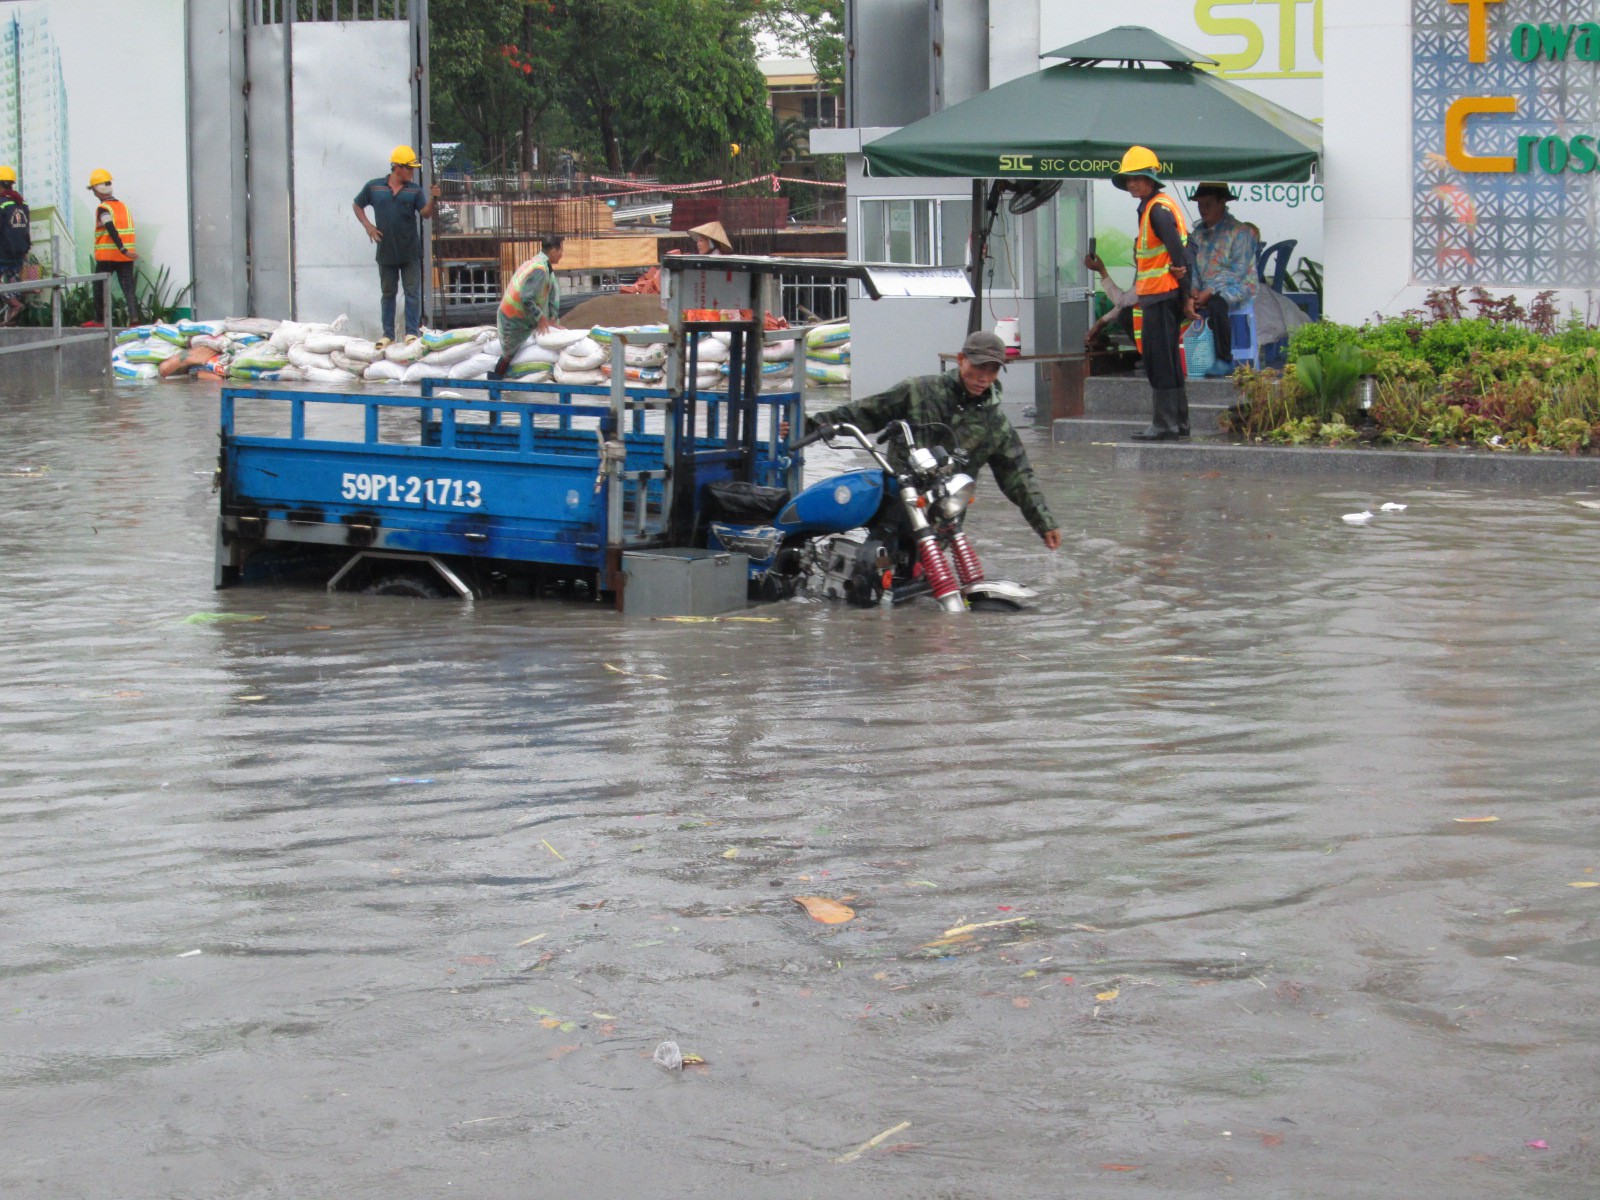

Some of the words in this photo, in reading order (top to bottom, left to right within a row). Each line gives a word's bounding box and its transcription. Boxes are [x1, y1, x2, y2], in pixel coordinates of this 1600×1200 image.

[1193, 0, 1323, 76] ST
[1445, 97, 1600, 174] Cros
[999, 155, 1033, 171] STC
[1040, 159, 1065, 171] STC
